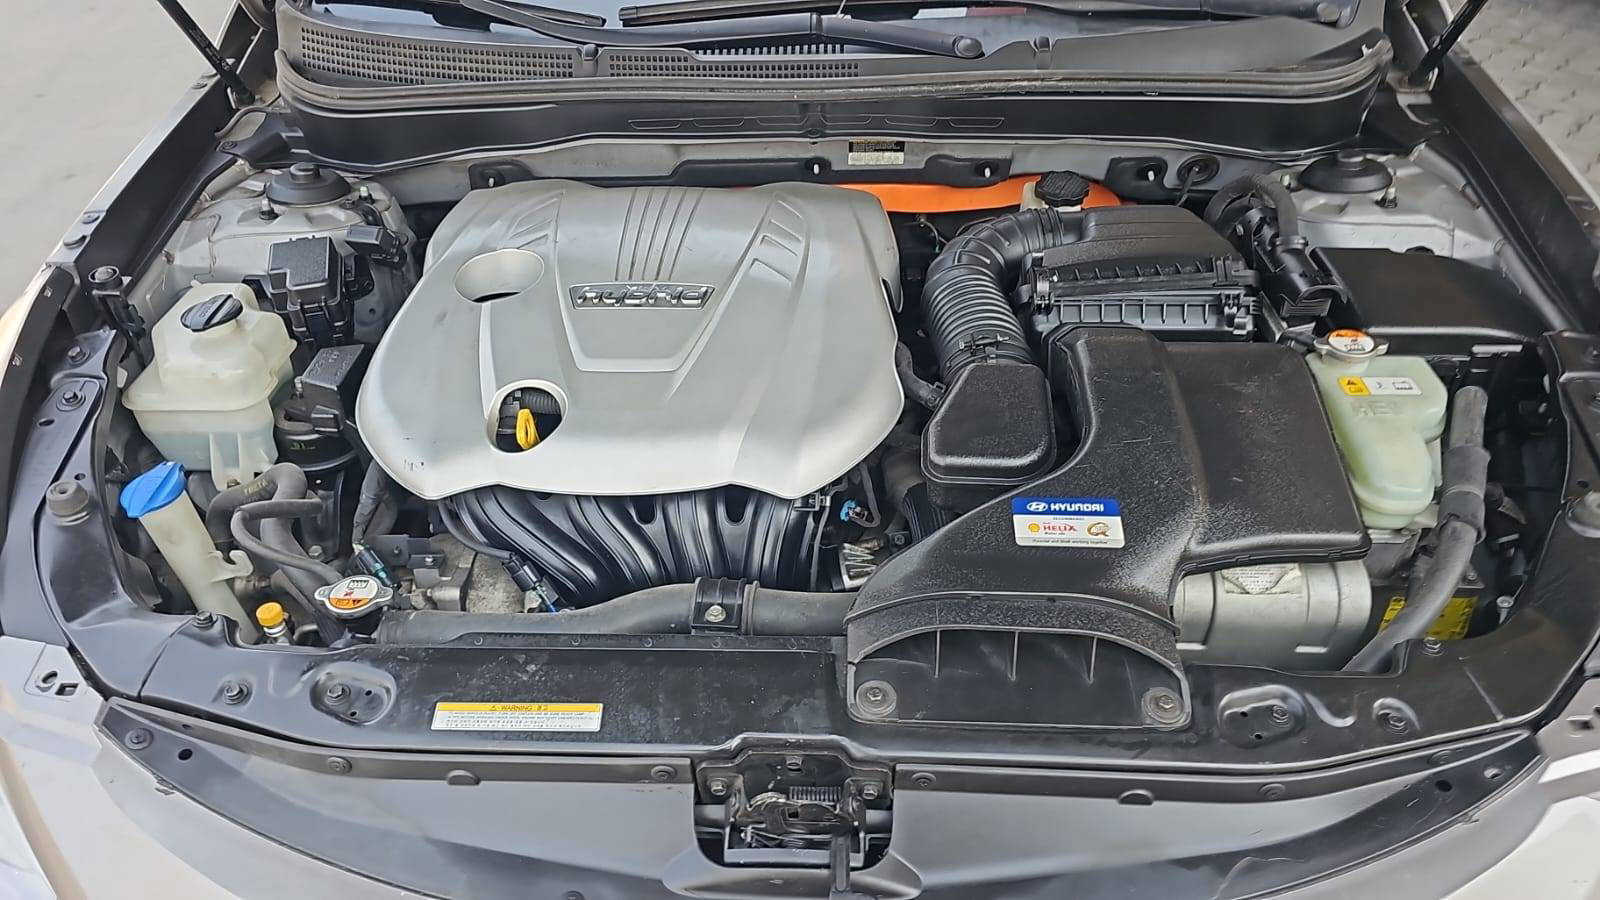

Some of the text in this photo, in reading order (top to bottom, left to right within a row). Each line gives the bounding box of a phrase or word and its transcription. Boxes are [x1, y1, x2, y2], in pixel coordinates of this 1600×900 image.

[577, 285, 708, 306] hybrid
[1050, 503, 1105, 512] HYUNDAI
[1042, 524, 1077, 532] HELIX
